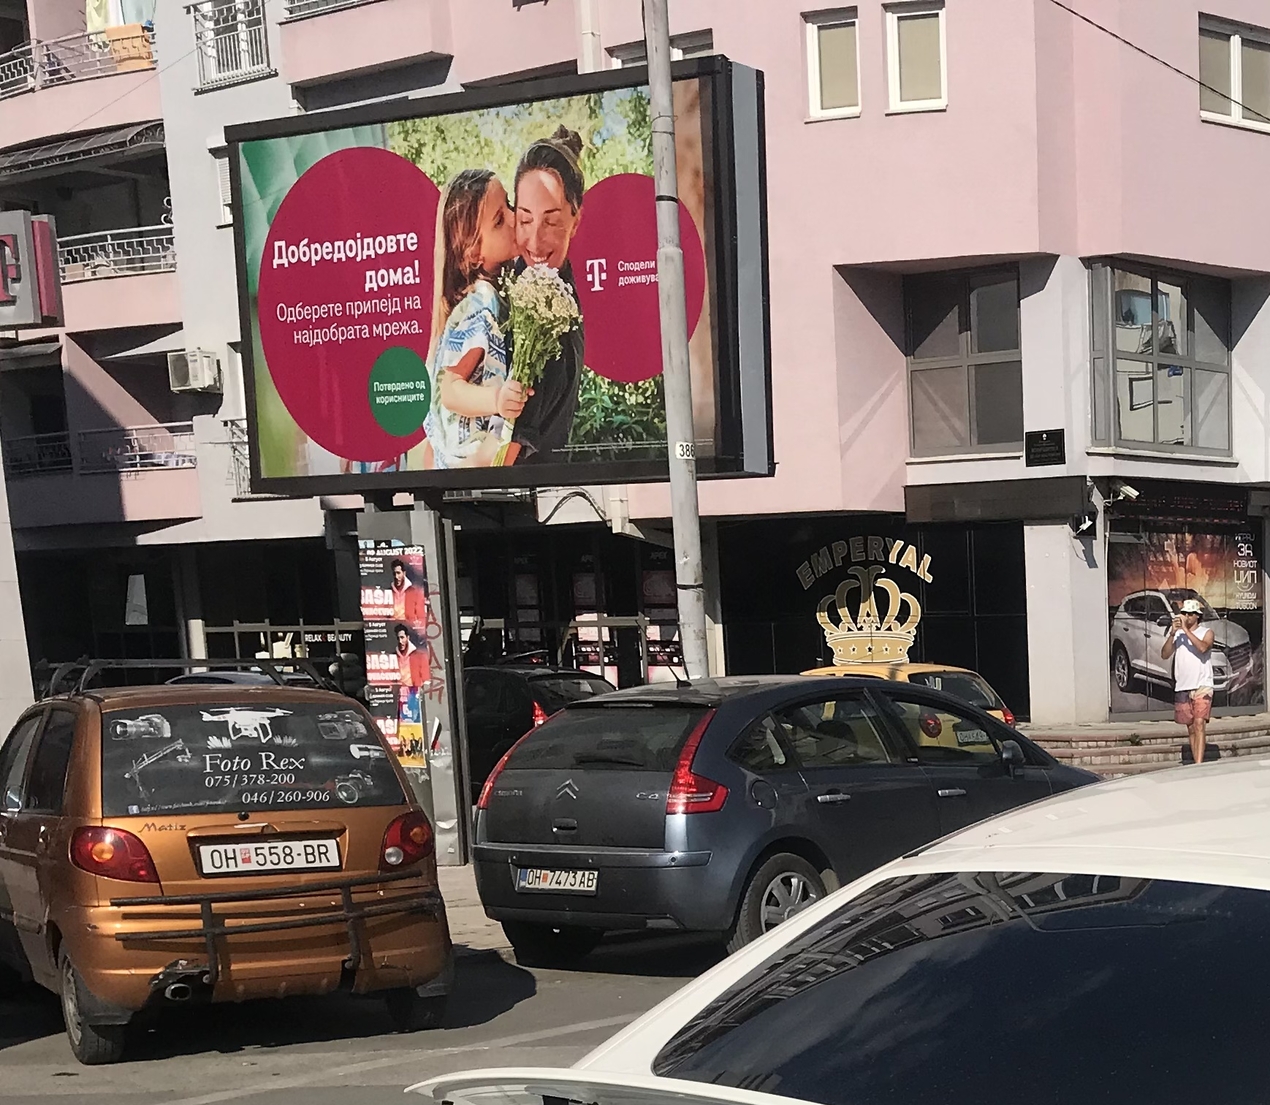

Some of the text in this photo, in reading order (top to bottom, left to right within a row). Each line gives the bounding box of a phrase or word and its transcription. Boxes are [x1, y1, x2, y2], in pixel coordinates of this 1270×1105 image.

[272, 231, 418, 269] Добредојдовте
[364, 259, 421, 292] дома!
[617, 260, 656, 272] Сподели
[276, 292, 422, 324] Одберете припејд на
[293, 319, 423, 347] најдобрата мрежа.
[373, 379, 426, 394] Потврдено од
[1237, 543, 1254, 557] ЗА
[795, 535, 934, 591] EMPERYAL
[1233, 560, 1258, 568] НОВИОТ
[305, 634, 322, 642] RELAX
[203, 751, 306, 773] Foto Rex
[138, 822, 187, 834] Matiz
[210, 848, 239, 870] OH
[527, 869, 541, 886] OH
[549, 871, 577, 887] 7473
